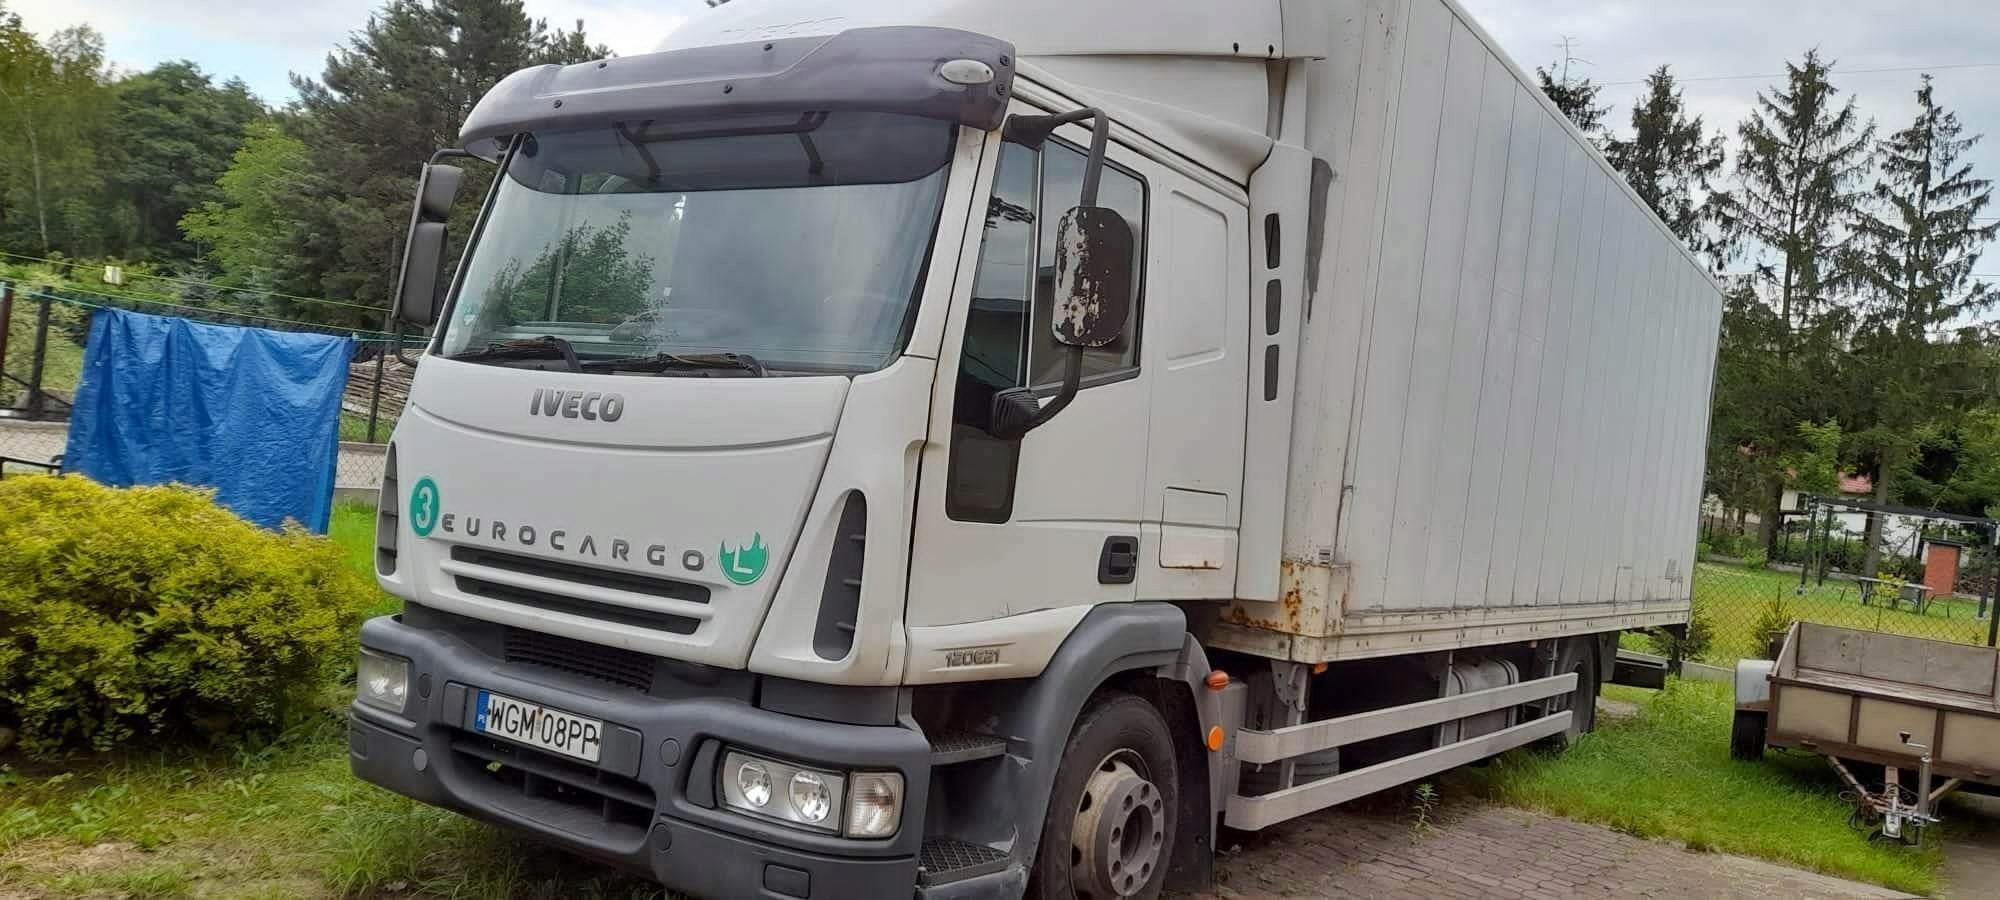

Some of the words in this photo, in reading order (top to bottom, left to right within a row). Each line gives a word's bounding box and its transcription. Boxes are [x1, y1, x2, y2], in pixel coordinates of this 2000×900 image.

[530, 388, 624, 422] IVECO
[415, 485, 432, 529] 3
[441, 512, 705, 572] EUROCARGO
[490, 699, 537, 740] WGM
[541, 713, 598, 755] 08PP
